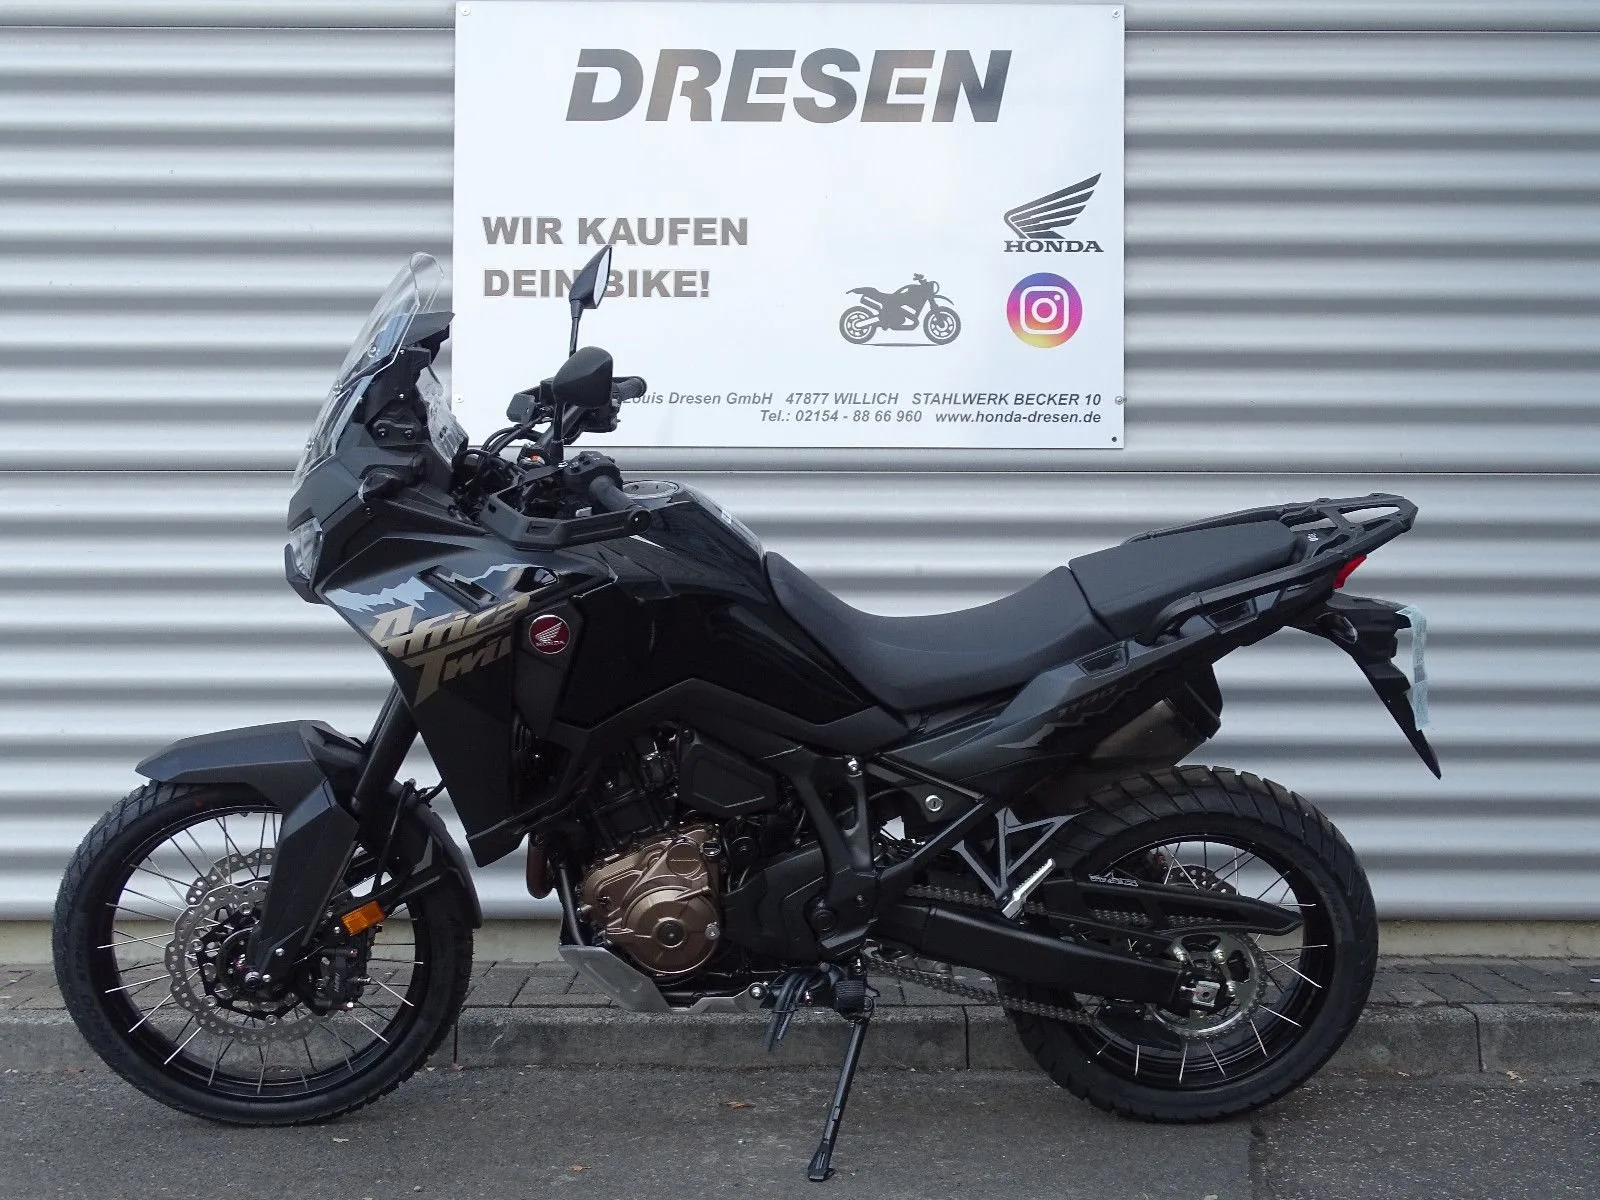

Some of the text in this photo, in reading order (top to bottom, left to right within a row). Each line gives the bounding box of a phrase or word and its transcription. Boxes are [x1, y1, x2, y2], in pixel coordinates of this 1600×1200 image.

[566, 48, 1012, 123] DRESEN
[483, 216, 748, 246] WIR KAUFEN
[1004, 240, 1104, 252] HONDA
[485, 269, 709, 298] DEIN BIKE!
[669, 391, 721, 405] Dresen
[726, 391, 773, 405] GmbH
[785, 392, 830, 405] 47877
[834, 392, 899, 405] WILLICH
[911, 393, 1010, 406] STAHLWERK
[1013, 393, 1080, 406] BECKER
[1085, 393, 1102, 406] 10
[760, 409, 790, 422] Tel.:
[795, 409, 839, 422] 02154
[852, 409, 870, 423] 88
[874, 410, 892, 423] 66
[896, 410, 923, 423] 960
[935, 410, 1102, 424] www.honda-dresen.de
